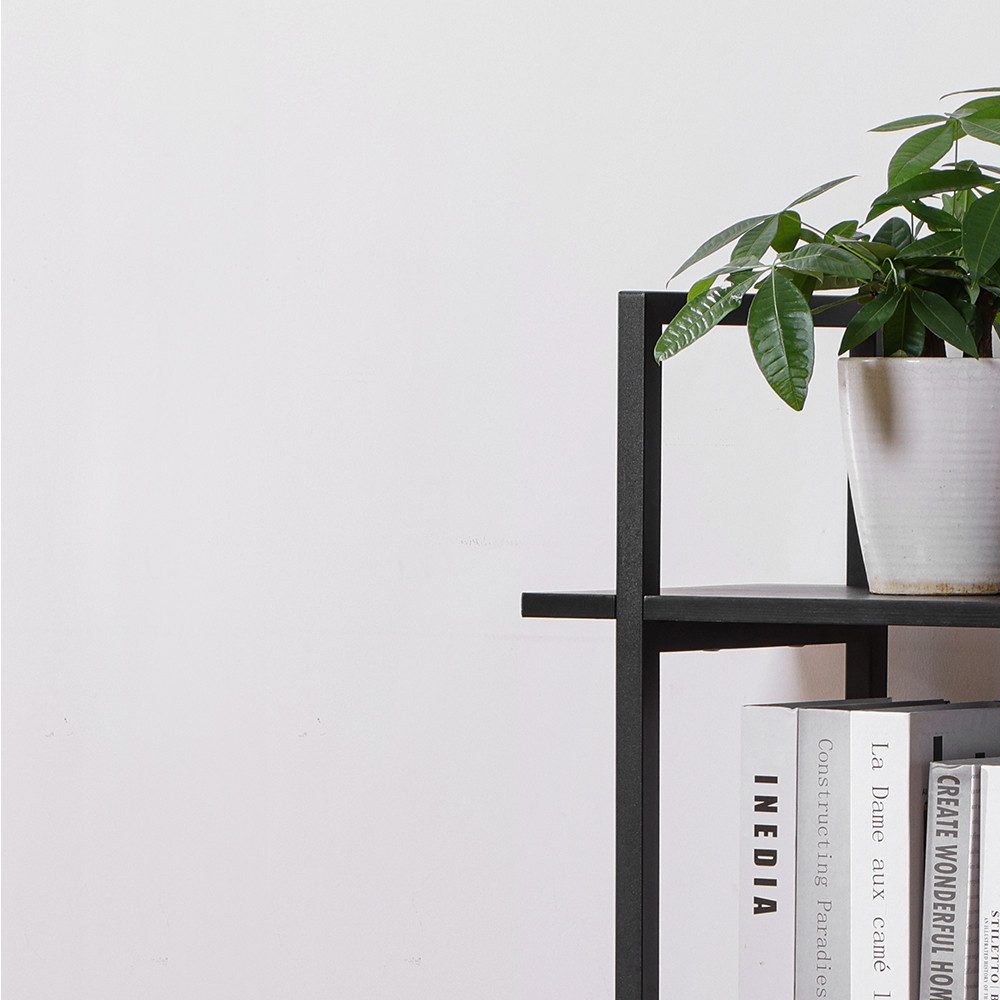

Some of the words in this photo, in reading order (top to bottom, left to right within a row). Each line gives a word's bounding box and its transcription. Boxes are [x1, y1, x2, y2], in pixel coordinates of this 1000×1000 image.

[870, 741, 889, 771] La
[814, 737, 834, 888] Constructing
[871, 785, 890, 843] Dame
[935, 774, 960, 838] CREATE
[753, 774, 778, 916] INEDIA
[872, 858, 885, 900] aux
[930, 843, 958, 954] WONDERFUL
[815, 899, 833, 999] Paradies
[872, 916, 891, 973] camé
[990, 910, 1000, 984] STILETTO
